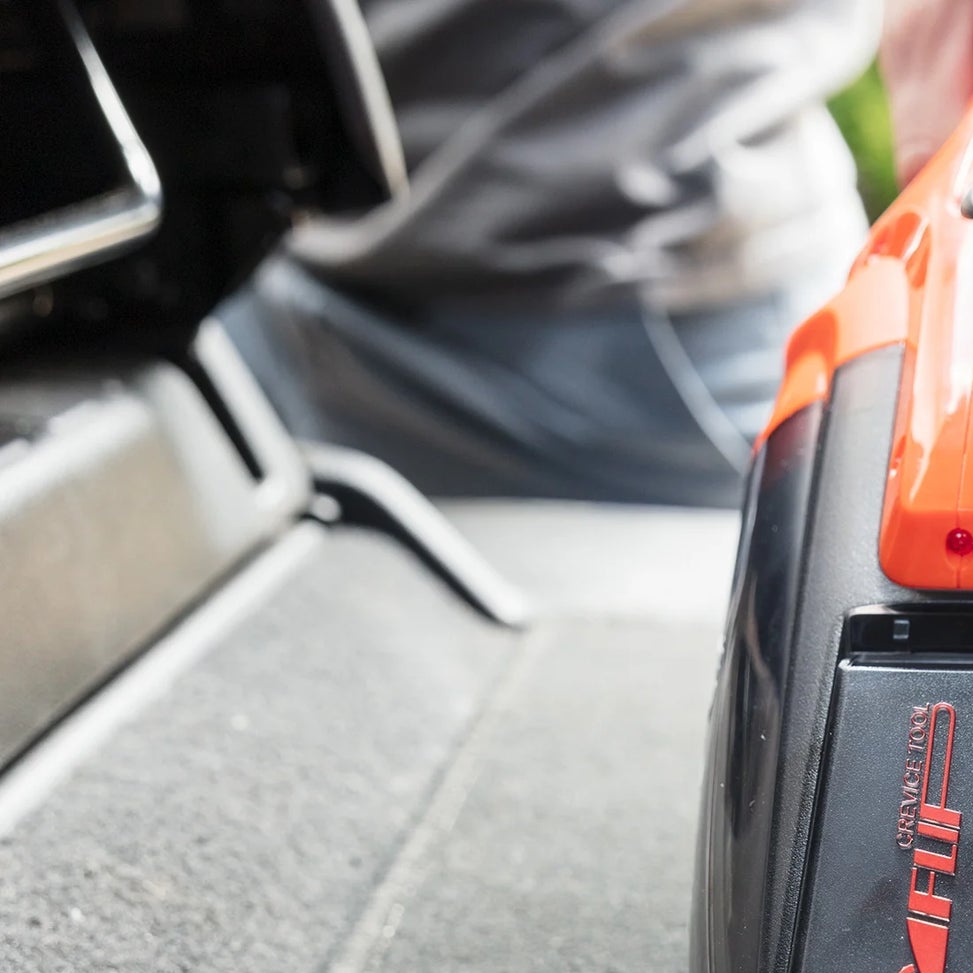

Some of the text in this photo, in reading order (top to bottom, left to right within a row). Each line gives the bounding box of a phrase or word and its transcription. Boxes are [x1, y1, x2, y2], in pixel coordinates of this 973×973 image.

[896, 702, 930, 849] CREVICE TOOL
[907, 701, 962, 922] FLIP
